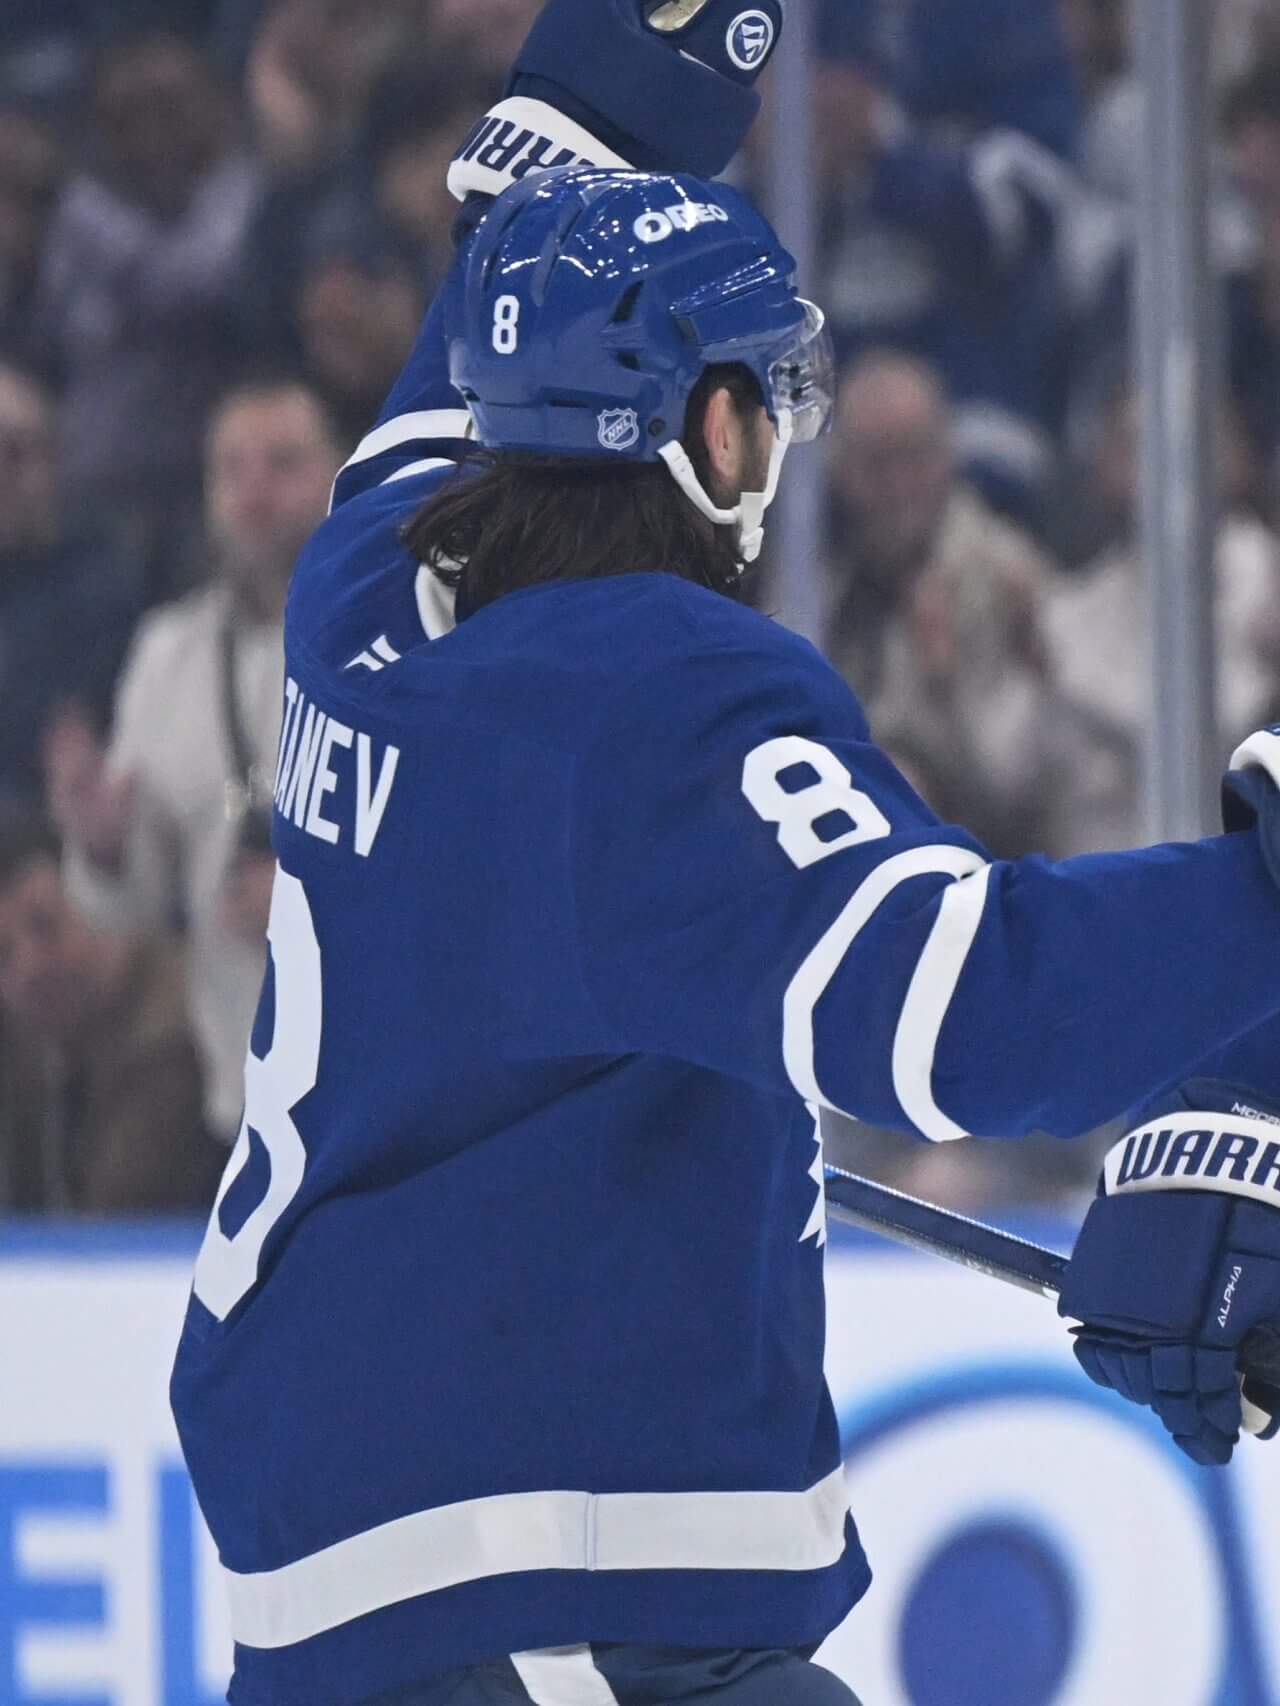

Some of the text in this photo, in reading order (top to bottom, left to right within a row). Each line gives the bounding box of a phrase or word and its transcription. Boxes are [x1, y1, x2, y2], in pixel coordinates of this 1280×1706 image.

[492, 295, 519, 355] 8
[273, 677, 401, 858] TANEV
[741, 735, 891, 869] 8
[193, 857, 322, 1323] 8
[1217, 1265, 1242, 1328] ALPHA
